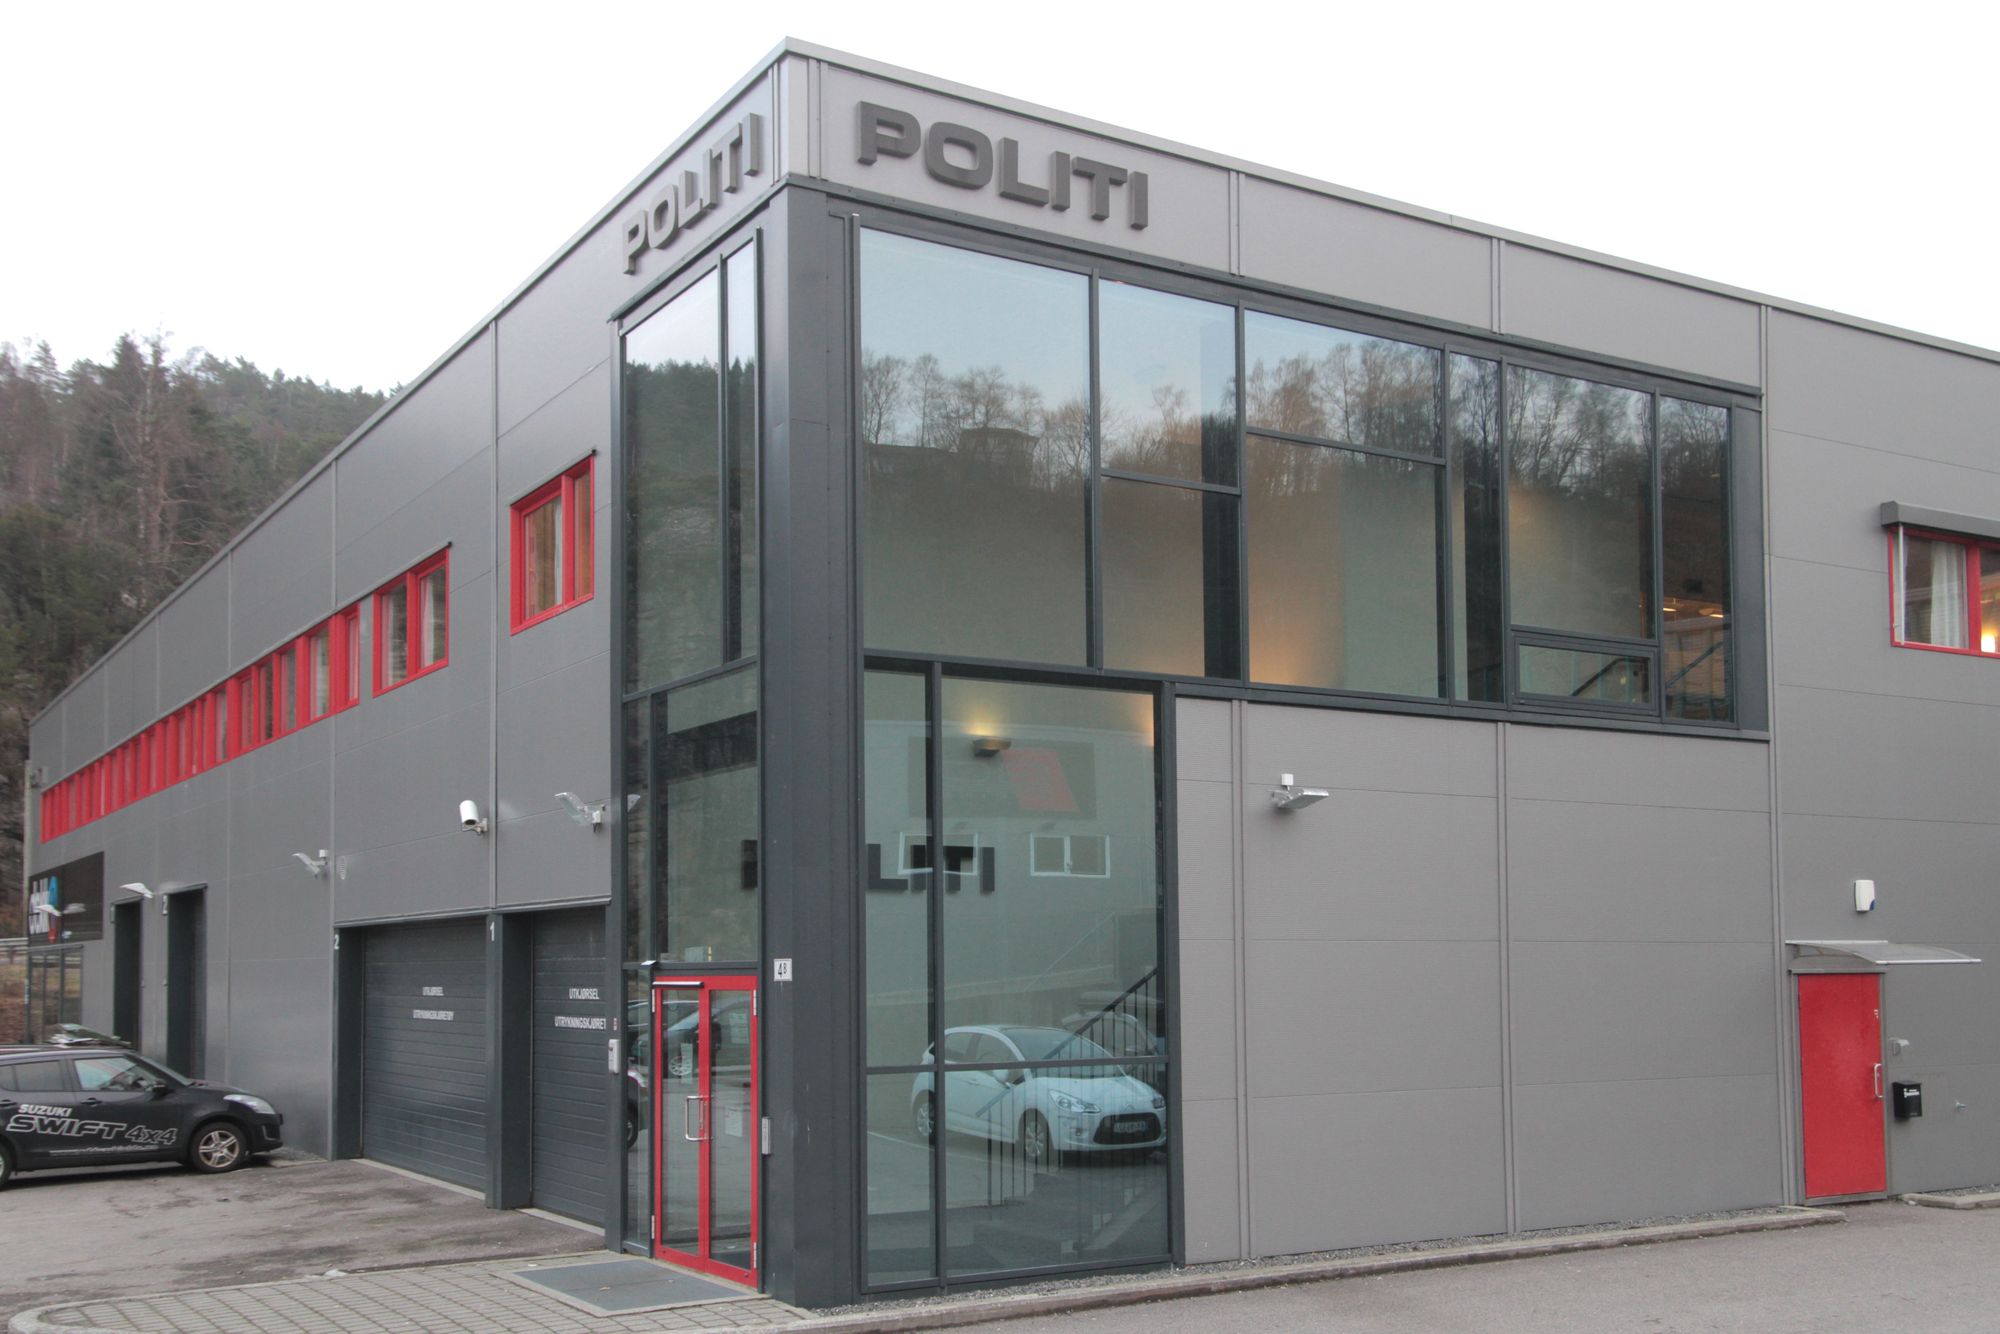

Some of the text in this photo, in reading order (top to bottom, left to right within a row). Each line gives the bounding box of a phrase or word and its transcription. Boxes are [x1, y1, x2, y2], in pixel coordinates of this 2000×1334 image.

[857, 100, 1149, 230] POLITI
[622, 112, 763, 275] POLITI
[866, 843, 995, 893] LITI
[334, 934, 340, 949] 2
[489, 921, 495, 941] 1
[18, 1103, 73, 1117] SUZUKI
[6, 1114, 127, 1139] SWIFT
